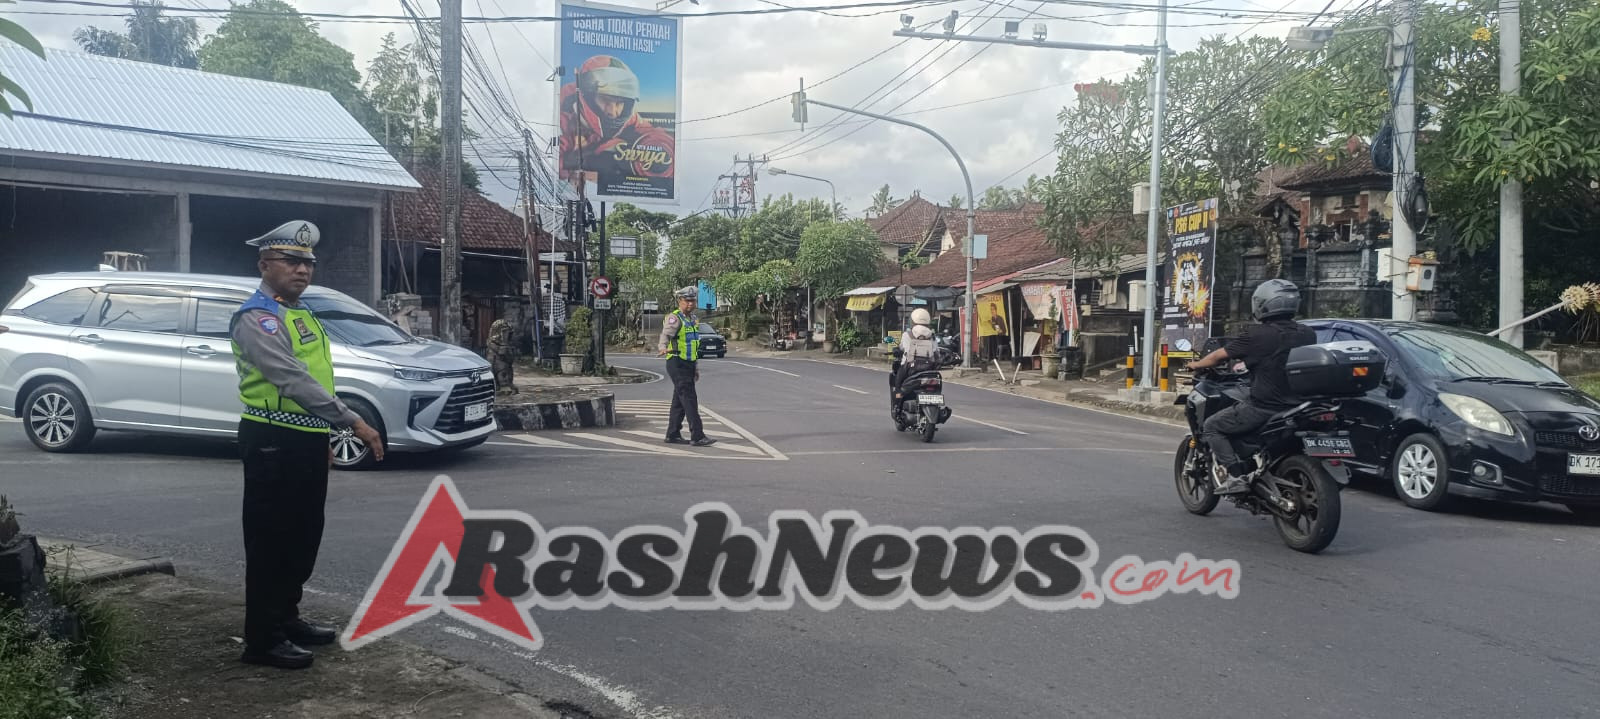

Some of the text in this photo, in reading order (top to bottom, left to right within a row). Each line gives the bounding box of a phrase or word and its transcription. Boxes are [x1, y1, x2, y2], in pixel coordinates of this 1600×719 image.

[607, 17, 634, 36] TIDAK
[635, 21, 671, 40] PERNAH
[573, 29, 632, 50] MENGKHIANATI
[613, 142, 673, 171] Surya
[1188, 212, 1202, 232] CUP
[1570, 456, 1581, 468] DK
